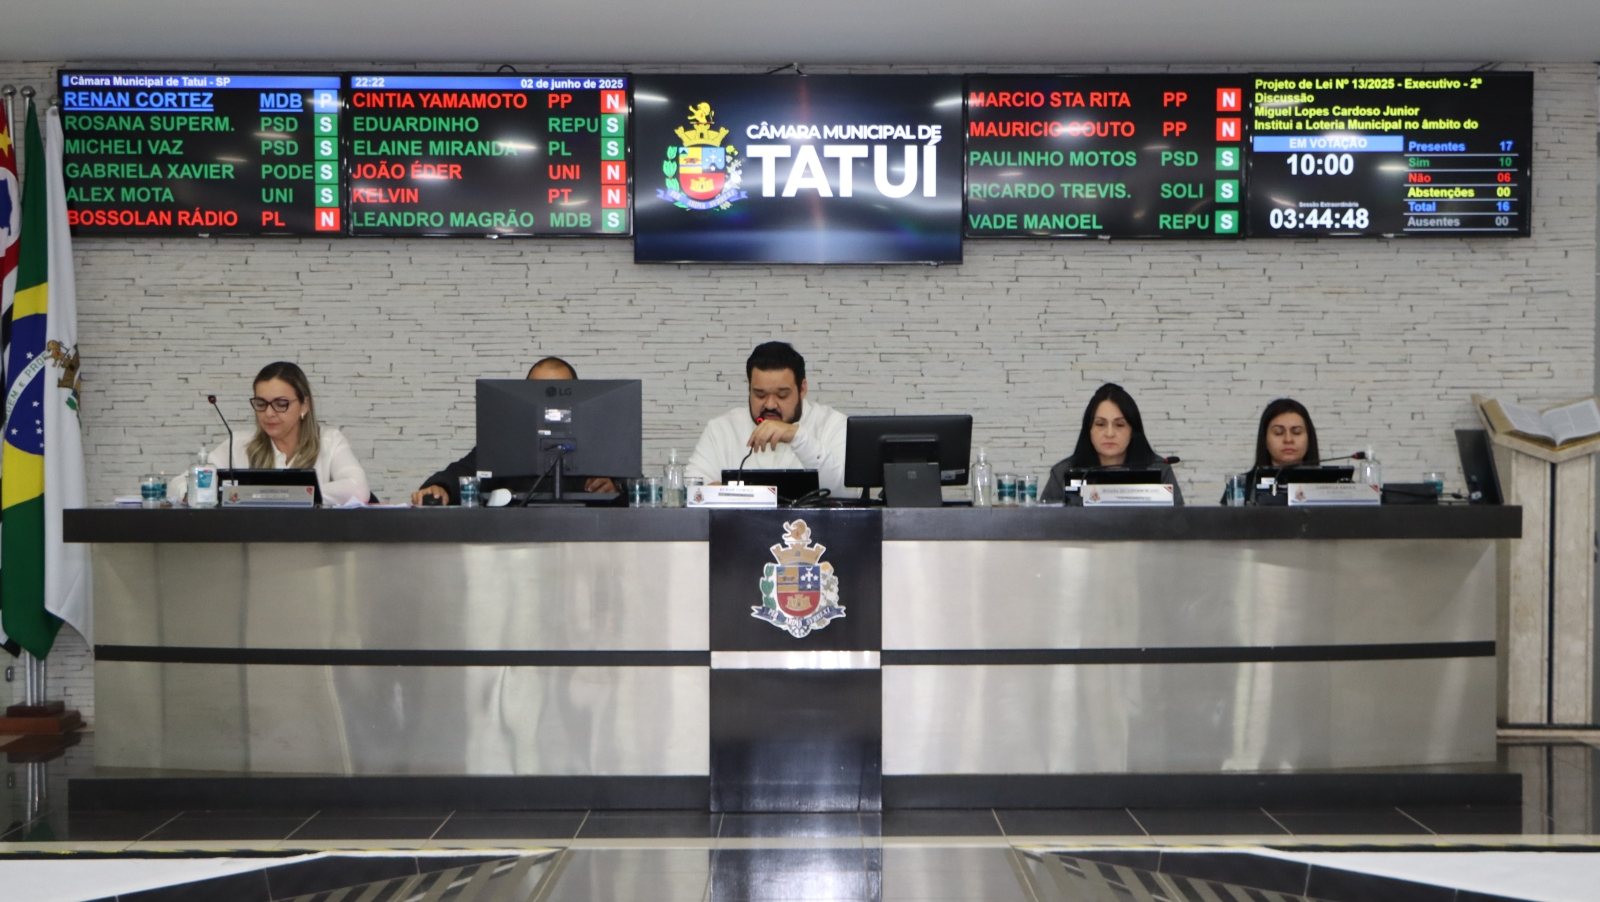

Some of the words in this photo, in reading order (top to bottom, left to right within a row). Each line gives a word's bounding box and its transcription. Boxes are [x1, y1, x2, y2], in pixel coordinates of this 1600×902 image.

[70, 76, 111, 86] Câmara
[113, 76, 164, 88] Municipal
[166, 77, 179, 86] de
[182, 77, 207, 86] Tatuí
[215, 77, 231, 87] SP
[355, 78, 385, 88] 22:22
[520, 79, 534, 89] 02
[536, 79, 549, 89] de
[550, 79, 581, 90] junho
[583, 79, 596, 89] de
[598, 79, 624, 89] 2025
[1255, 79, 1296, 91] Projeto
[1299, 79, 1313, 89] de
[1315, 79, 1333, 89] Lei
[1351, 79, 1394, 89] 13/2025
[1404, 79, 1460, 89] Executivo
[64, 92, 131, 108] RENAN
[135, 92, 214, 108] CORTEZ
[259, 93, 303, 108] MDB
[320, 93, 332, 107] P
[352, 92, 415, 108] CINTIA
[419, 93, 527, 109] YAMAMOTO
[548, 93, 572, 109] PP
[606, 94, 619, 109] N
[969, 92, 1045, 107] MARCIO
[1050, 92, 1085, 108] STA
[1090, 92, 1131, 108] RITA
[1163, 92, 1187, 107] PP
[1222, 92, 1235, 107] N
[1255, 92, 1314, 103] Discussão
[1255, 106, 1292, 118] Miguel
[1295, 106, 1329, 118] Lopes
[1332, 106, 1380, 117] Cardoso
[1383, 106, 1420, 117] Junior
[64, 116, 145, 131] ROSANA
[150, 116, 235, 132] SUPERM.
[261, 117, 299, 132] PSD
[320, 117, 332, 132] S
[353, 117, 479, 133] EDUARDINHO
[548, 117, 599, 133] REPU
[606, 118, 619, 133] S
[747, 122, 821, 140] CÂMARA
[823, 124, 916, 140] MUNICIPAL
[917, 125, 942, 140] DE
[969, 121, 1062, 137] MAURICIO
[1068, 121, 1135, 137] COUTO
[1163, 122, 1187, 137] PP
[1222, 122, 1235, 137] N
[1254, 120, 1293, 130] Institui
[1296, 122, 1302, 130] a
[1305, 120, 1345, 130] Loteria
[1348, 120, 1402, 132] Municipal
[1422, 120, 1460, 130] âmbito
[1463, 120, 1479, 130] do
[65, 140, 142, 155] MICHELI
[147, 140, 183, 155] VAZ
[261, 141, 299, 156] PSD
[320, 141, 332, 156] S
[353, 140, 423, 156] ELAINE
[429, 140, 518, 156] MIRANDA
[548, 141, 572, 156] PL
[606, 141, 619, 156] S
[1289, 139, 1307, 148] EM
[1408, 142, 1466, 153] Presentes
[1500, 142, 1513, 151] 17
[969, 151, 1064, 167] PAULINHO
[1069, 151, 1137, 167] MOTOS
[1161, 151, 1199, 167] PSD
[1221, 151, 1234, 166] S
[1286, 154, 1354, 175] 10:00
[1408, 157, 1430, 167] Sim
[1500, 158, 1512, 167] 10
[65, 163, 163, 179] GABRIELA
[167, 164, 235, 179] XAVIER
[261, 165, 313, 180] PODE
[320, 165, 333, 180] S
[352, 160, 405, 180] JOÃO
[549, 165, 581, 180] UNI
[607, 165, 620, 180] N
[747, 136, 942, 198] TATUÍ
[1408, 173, 1431, 183] Não
[1497, 173, 1511, 183] 06
[65, 187, 115, 202] ALEX
[120, 187, 174, 203] MOTA
[262, 188, 293, 203] UNI
[320, 188, 333, 204] S
[352, 188, 419, 204] KELVIN
[548, 188, 572, 204] PT
[607, 189, 620, 204] N
[969, 183, 1055, 199] RICARDO
[1060, 183, 1131, 199] TREVIS.
[1160, 183, 1203, 199] SOLI
[1221, 183, 1233, 199] S
[1408, 187, 1475, 199] Abstenções
[1497, 188, 1511, 197] 00
[1408, 202, 1436, 212] Total
[1496, 202, 1510, 212] 16
[68, 210, 172, 226] BOSSOLAN
[178, 207, 238, 227] RÁDIO
[261, 211, 285, 227] PL
[321, 212, 334, 227] N
[352, 212, 444, 227] LEANDRO
[450, 209, 534, 228] MAGRÃO
[550, 212, 592, 227] MDB
[607, 213, 620, 228] S
[969, 214, 1018, 229] VADE
[1023, 214, 1103, 230] MANOEL
[1159, 214, 1209, 230] REPU
[1220, 214, 1233, 230] S
[1269, 208, 1369, 229] 03:44:48
[1408, 217, 1460, 227] Ausentes
[1495, 217, 1509, 226] 00
[559, 388, 572, 396] LG
